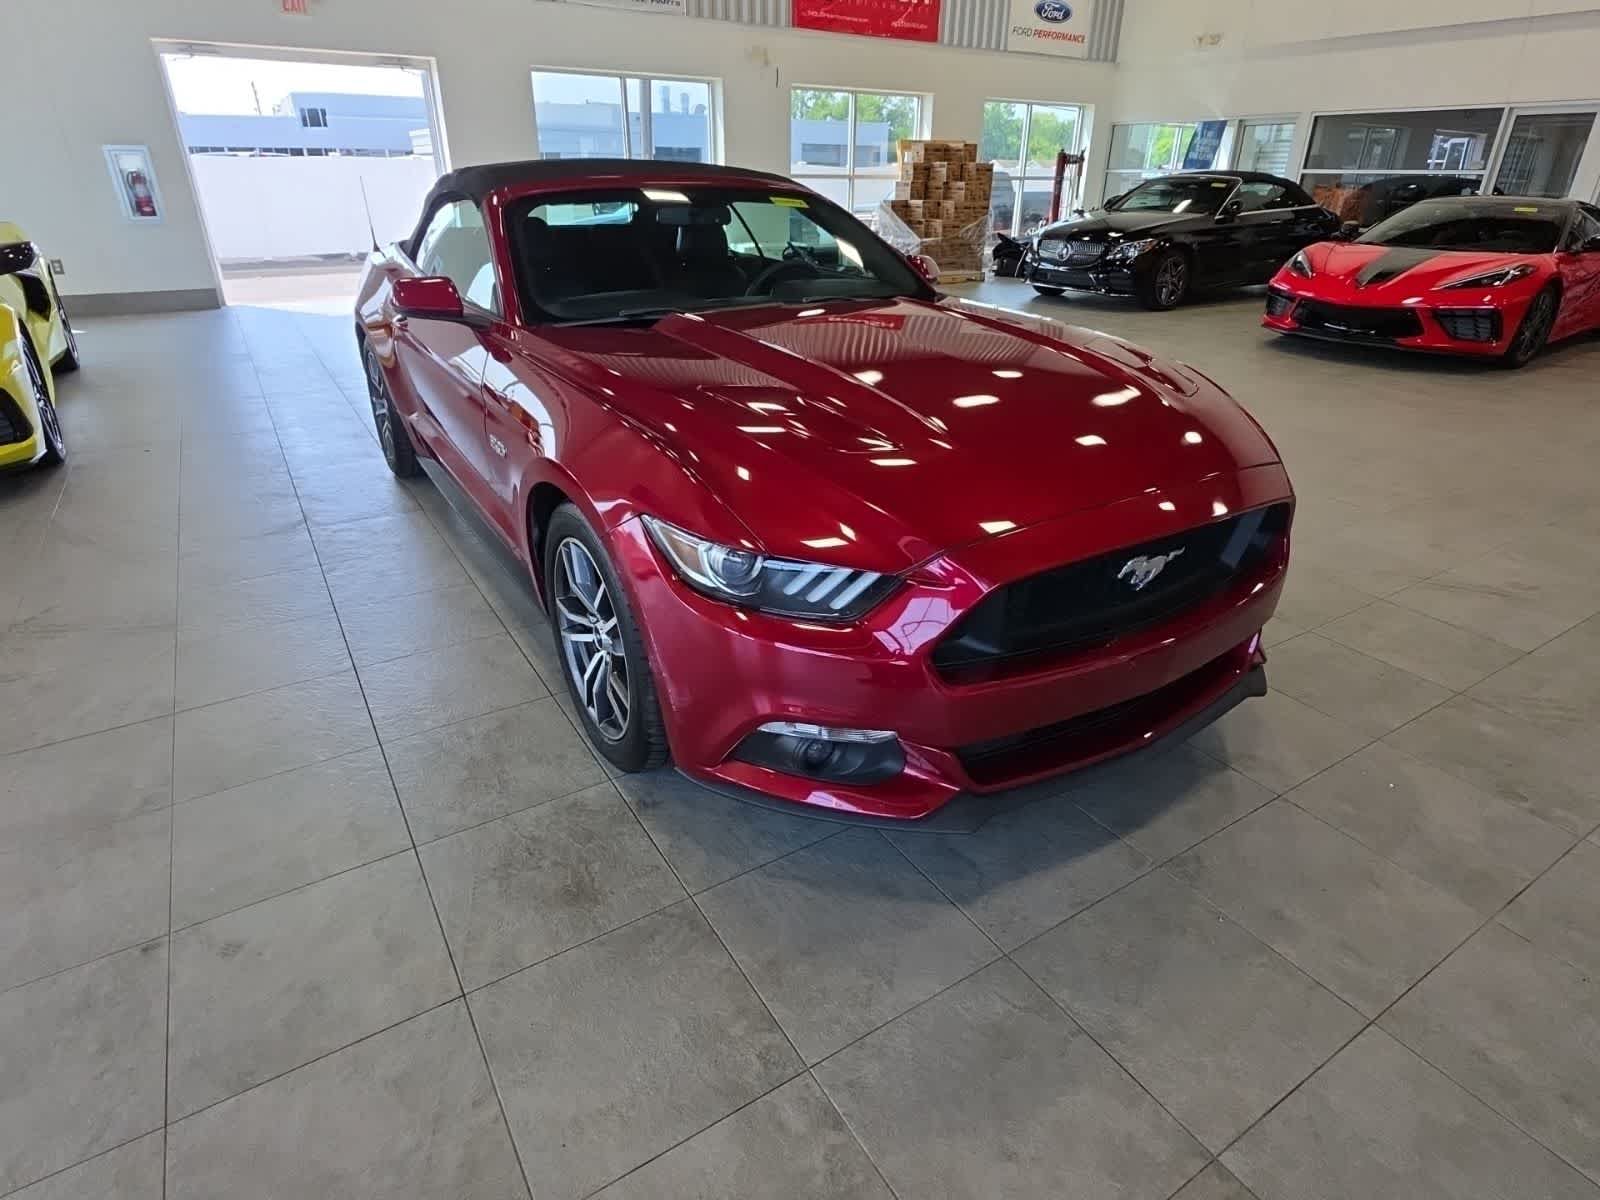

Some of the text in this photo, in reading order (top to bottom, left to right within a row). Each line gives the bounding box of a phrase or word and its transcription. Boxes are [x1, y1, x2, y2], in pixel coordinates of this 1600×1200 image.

[1041, 2, 1064, 20] Ford
[1012, 25, 1086, 43] FORD PERFORMANCE
